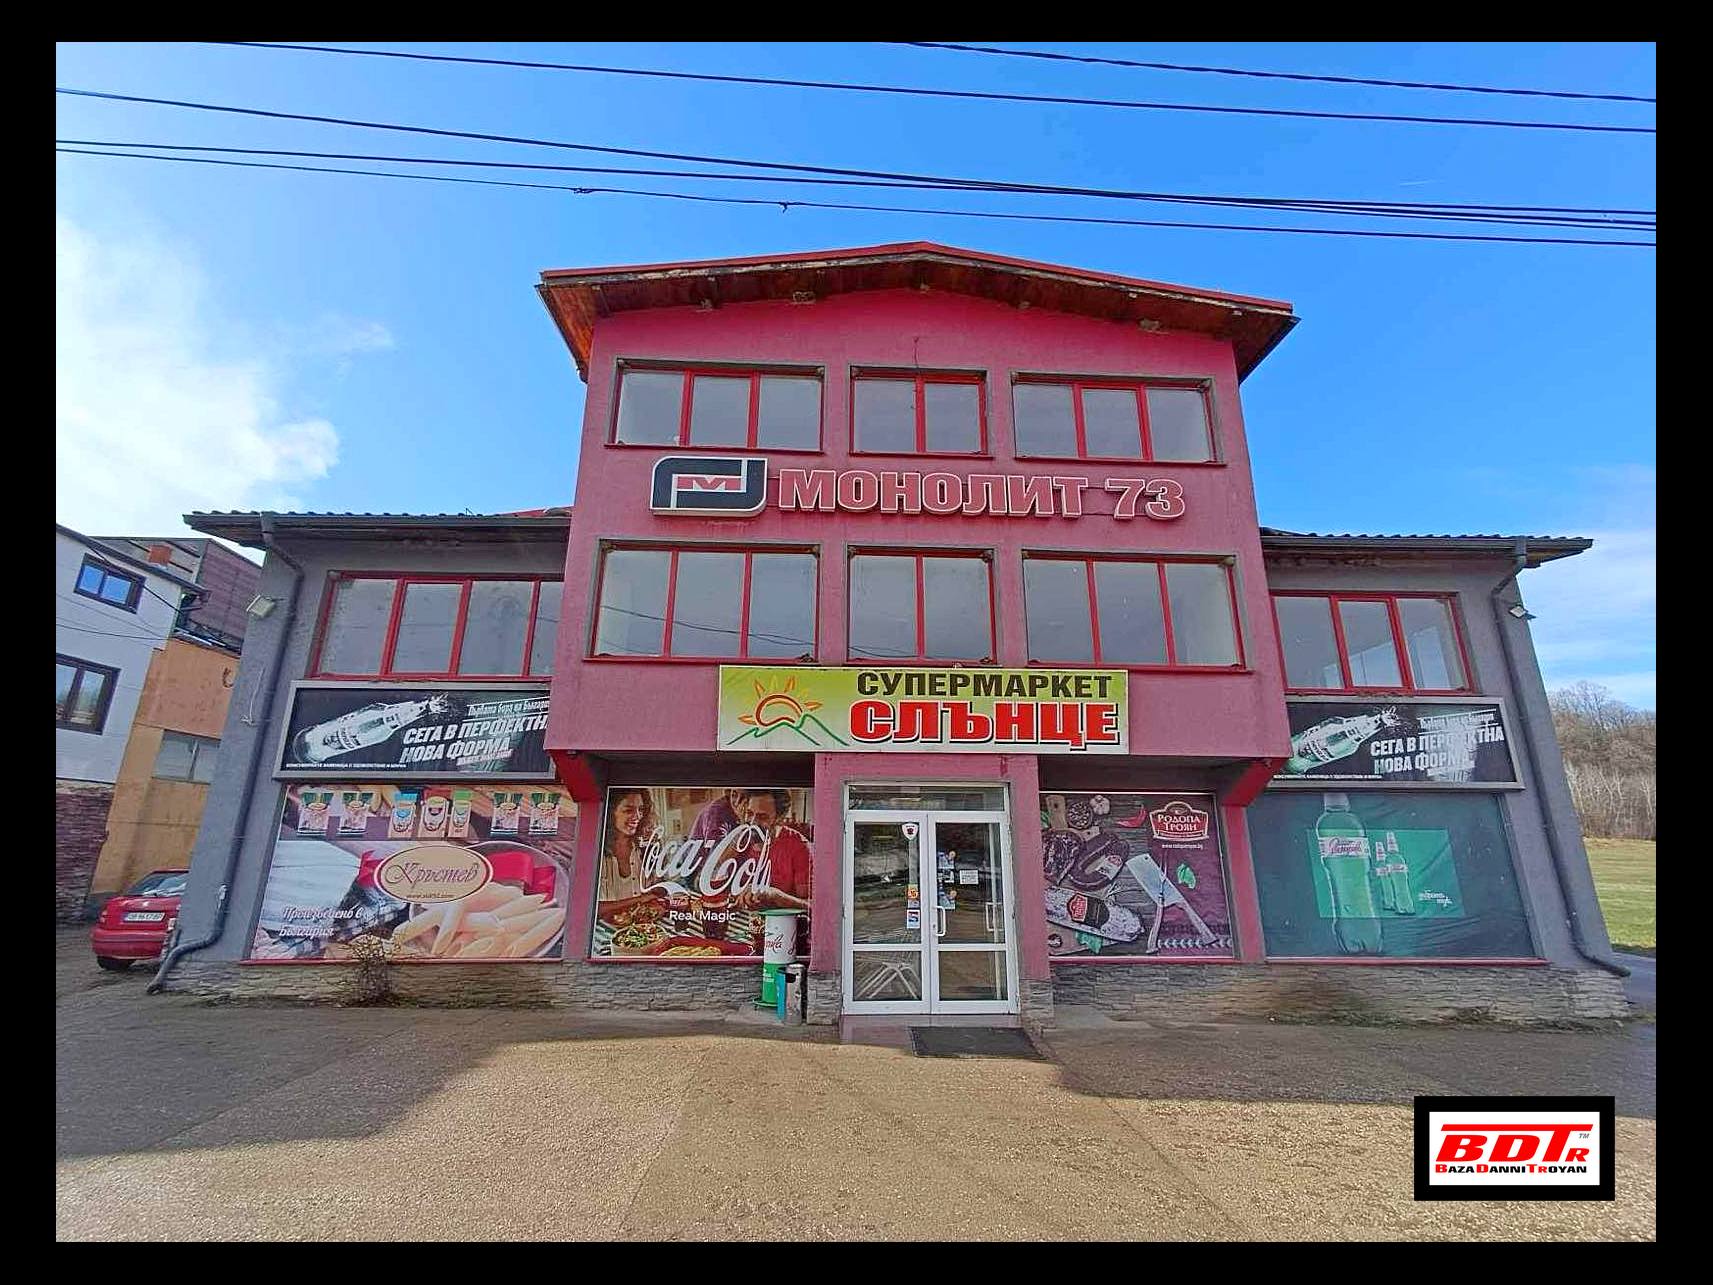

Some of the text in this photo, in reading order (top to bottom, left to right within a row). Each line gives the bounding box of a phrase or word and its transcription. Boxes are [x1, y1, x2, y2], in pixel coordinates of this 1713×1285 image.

[778, 469, 1186, 520] МОНОЛИТ 73
[856, 671, 1112, 698] СУПЕРМАРКЕТ
[403, 714, 549, 745] СЕГА В ПЕРФЕКТН
[848, 699, 1121, 751] СЛЪНЦЕ
[400, 743, 445, 763] НОВА
[447, 736, 511, 760] ФОРМА
[1370, 726, 1505, 757] СЕГА В ПЕРКТНА
[1374, 756, 1412, 774] НОВА
[1157, 814, 1201, 824] РОДОПА
[1163, 822, 1197, 831] ТРОЯН
[669, 910, 736, 923] Real Magic
